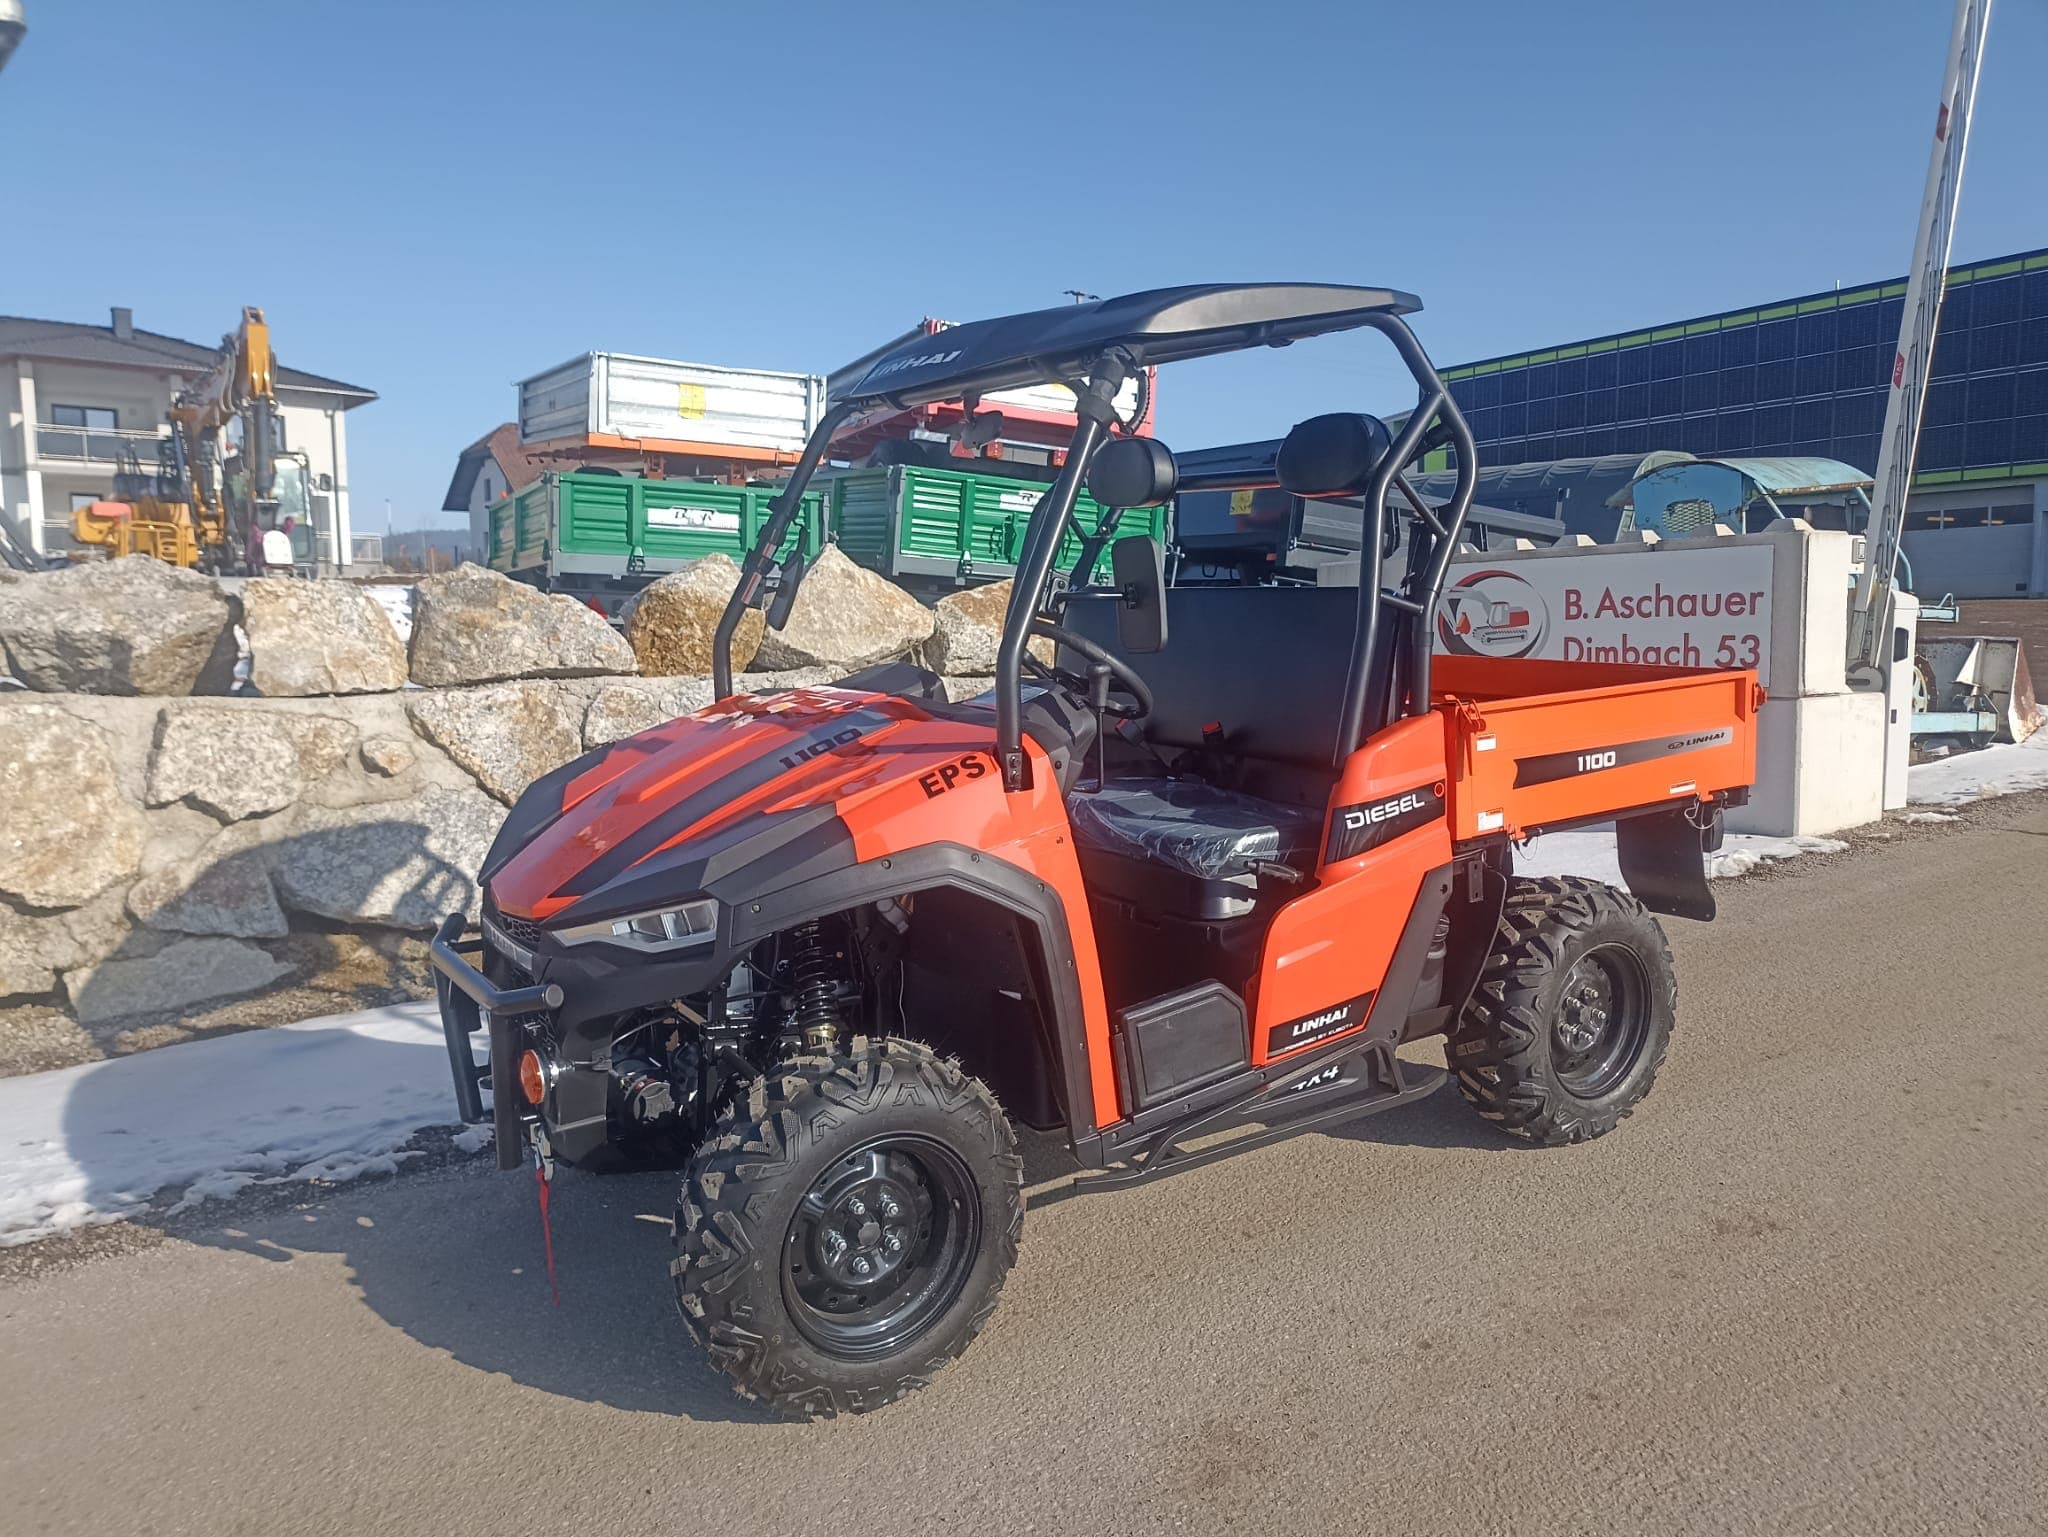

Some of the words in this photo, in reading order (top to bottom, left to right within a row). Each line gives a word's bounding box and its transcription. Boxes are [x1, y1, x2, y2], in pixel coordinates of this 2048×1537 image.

[1565, 589, 1588, 620] B.
[1594, 583, 1765, 618] Aschauer
[1563, 633, 1700, 666] Dimbach
[1714, 634, 1760, 668] 53
[779, 728, 862, 769] 1100
[1686, 732, 1725, 746] LINHAI
[918, 755, 985, 799] EPS
[1578, 751, 1616, 772] 1100
[1344, 794, 1425, 830] DIESEL
[1292, 1006, 1348, 1036] LINHAI
